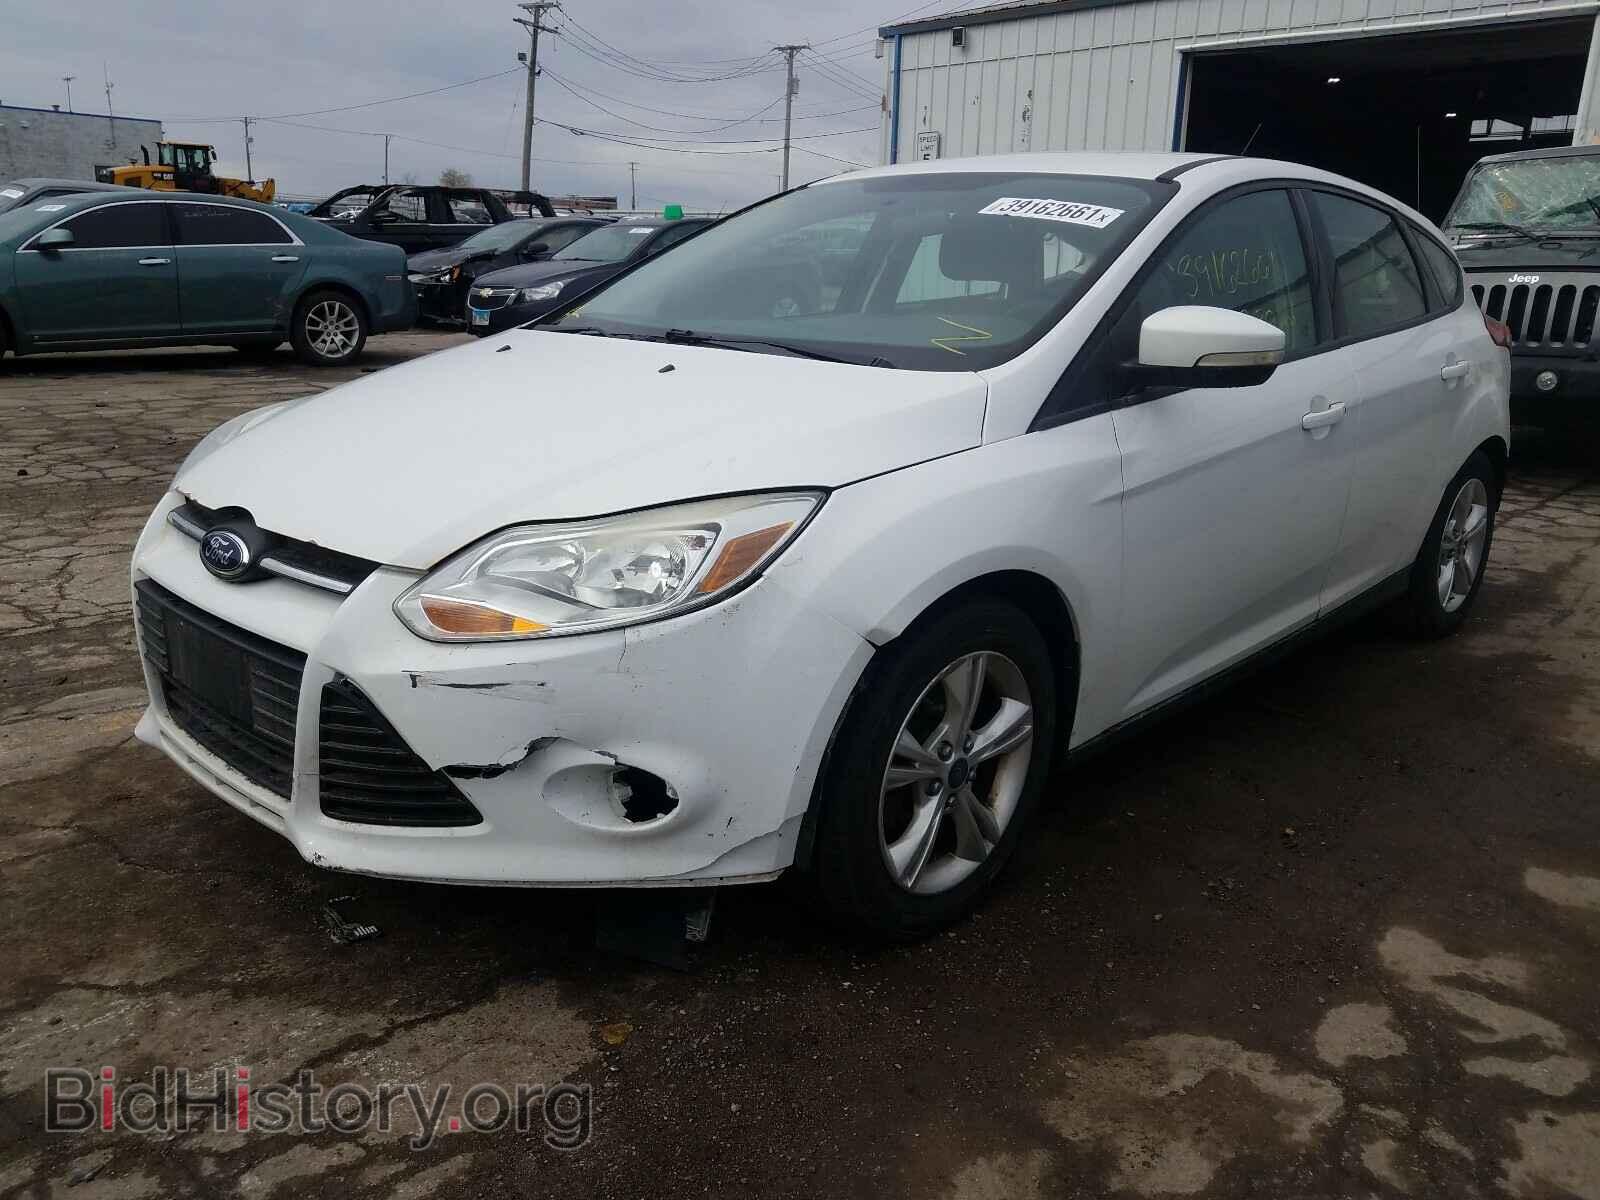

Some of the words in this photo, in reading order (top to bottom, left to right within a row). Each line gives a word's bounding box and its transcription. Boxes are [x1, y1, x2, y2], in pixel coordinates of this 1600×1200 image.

[919, 144, 935, 152] LIMIT
[1000, 199, 1102, 222] 39162661
[1508, 273, 1540, 284] Jeep
[204, 535, 234, 566] Ford
